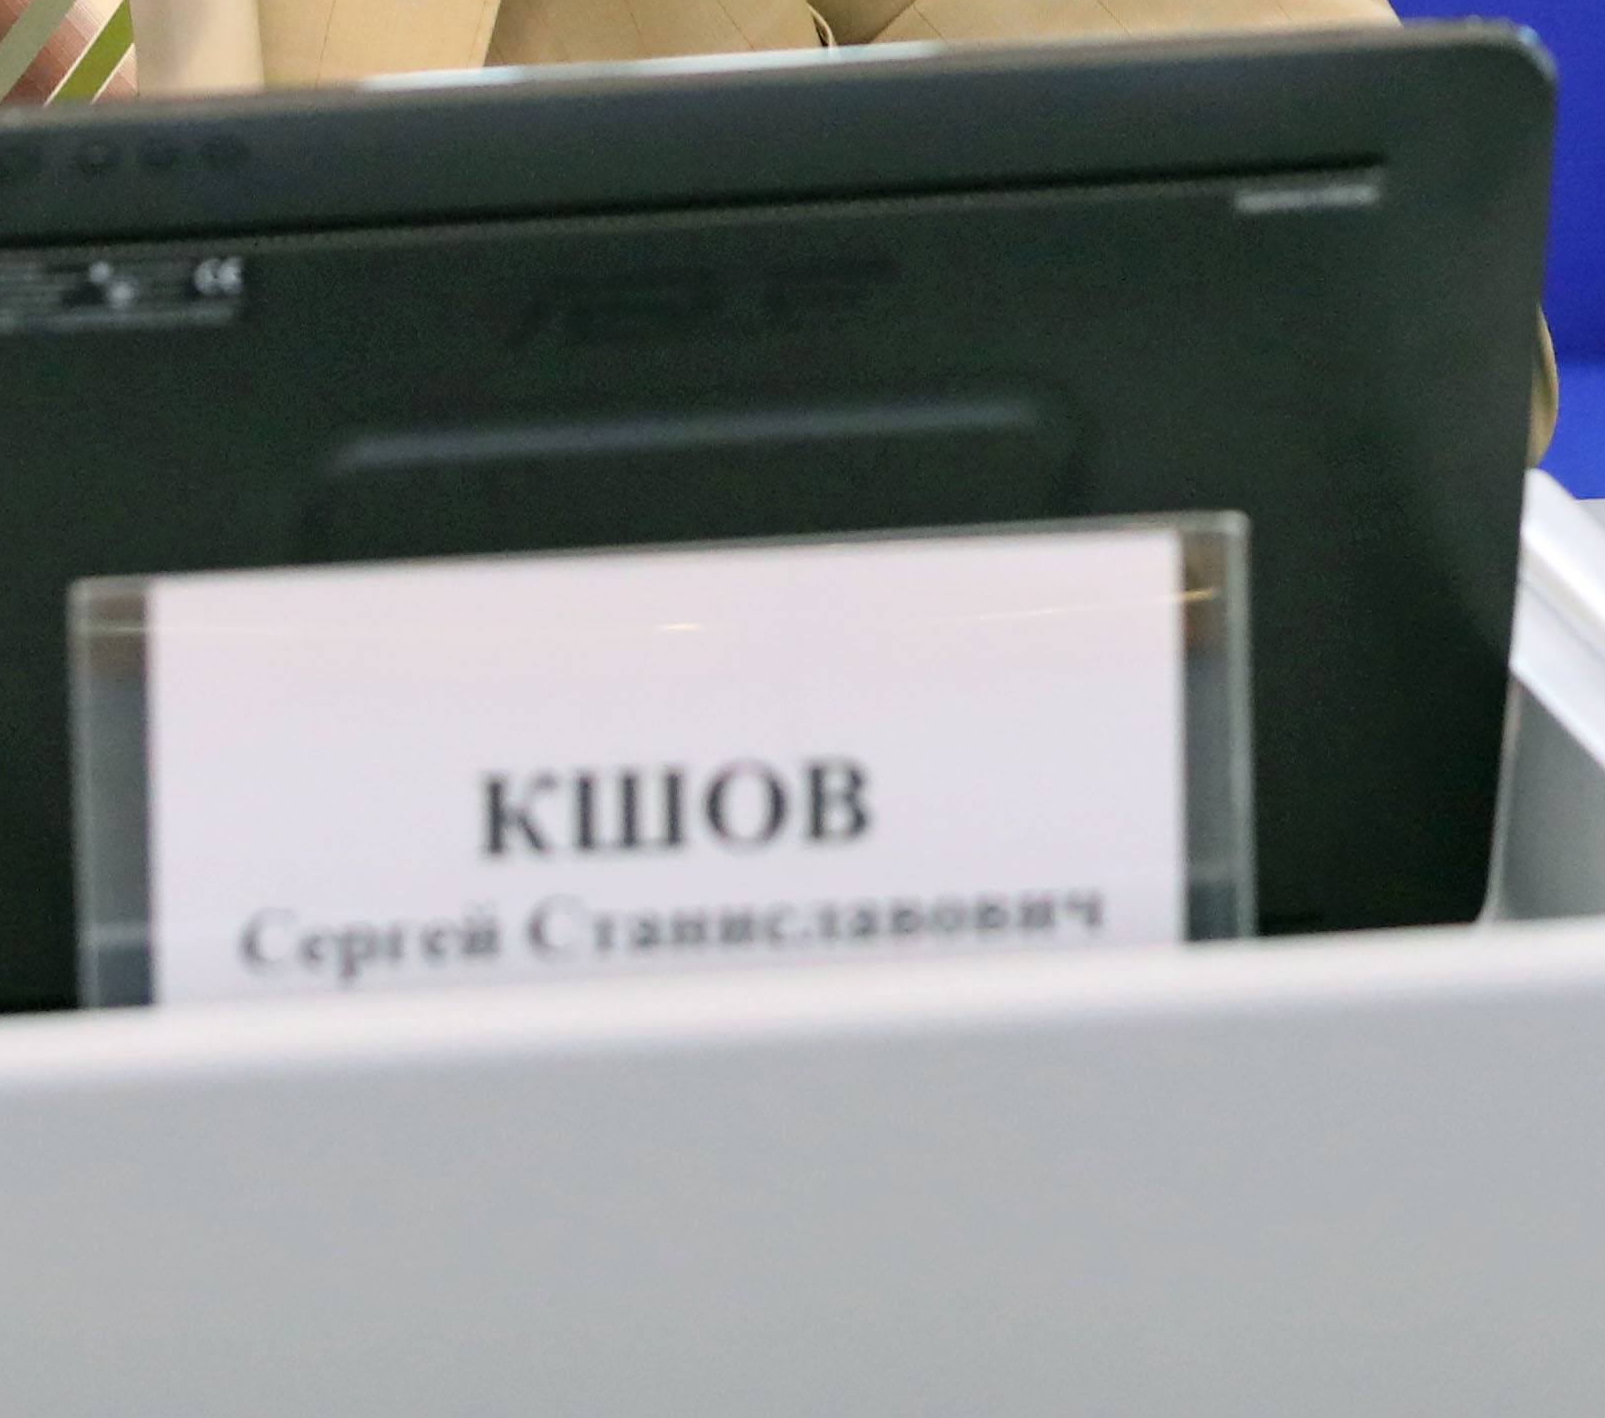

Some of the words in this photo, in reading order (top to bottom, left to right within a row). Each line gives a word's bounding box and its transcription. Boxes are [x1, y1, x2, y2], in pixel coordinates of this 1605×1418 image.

[479, 757, 874, 860] КШОВ
[238, 905, 503, 985] Сергей
[524, 885, 1107, 959] Станиславович
